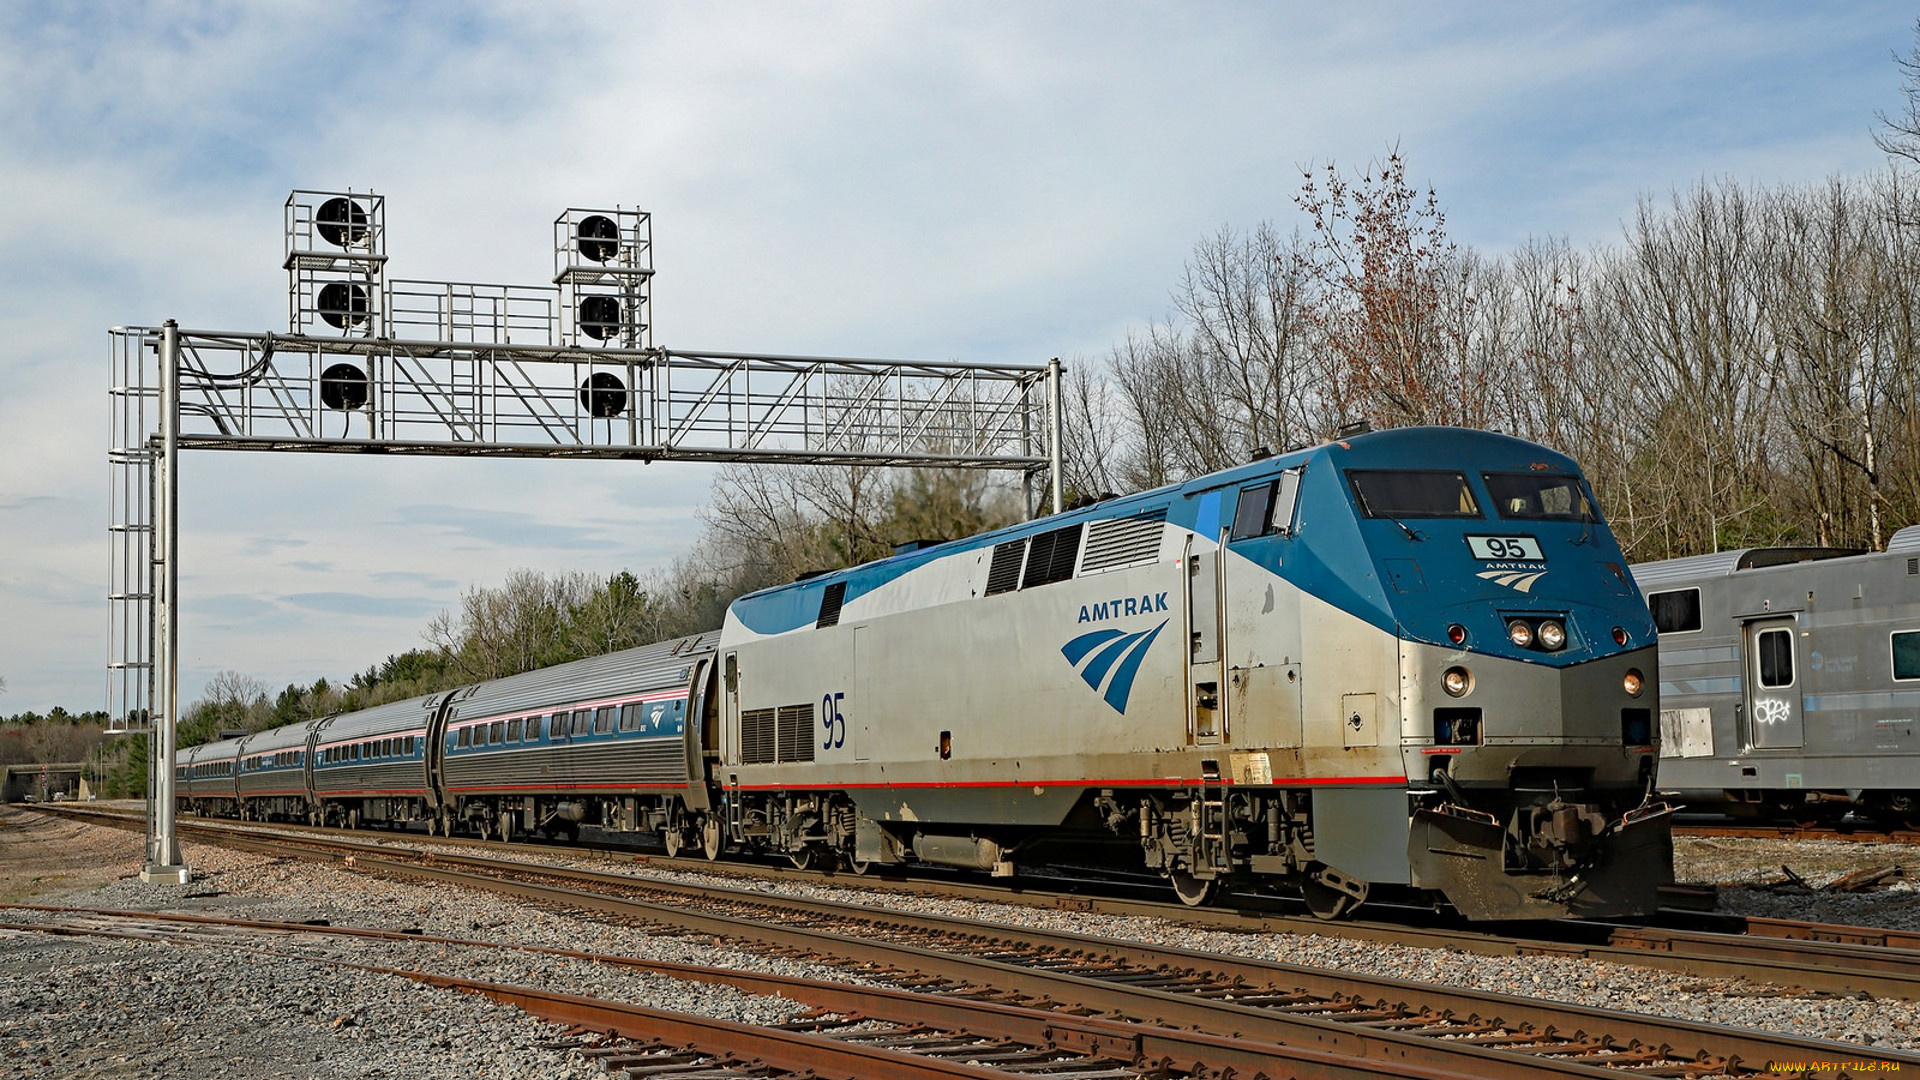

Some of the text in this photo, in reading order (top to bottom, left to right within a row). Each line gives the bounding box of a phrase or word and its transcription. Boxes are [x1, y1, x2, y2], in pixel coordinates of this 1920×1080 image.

[1486, 538, 1526, 558] 95
[1486, 562, 1547, 570] AMTRAK
[1078, 591, 1168, 623] AMTRAK
[822, 692, 846, 750] 95
